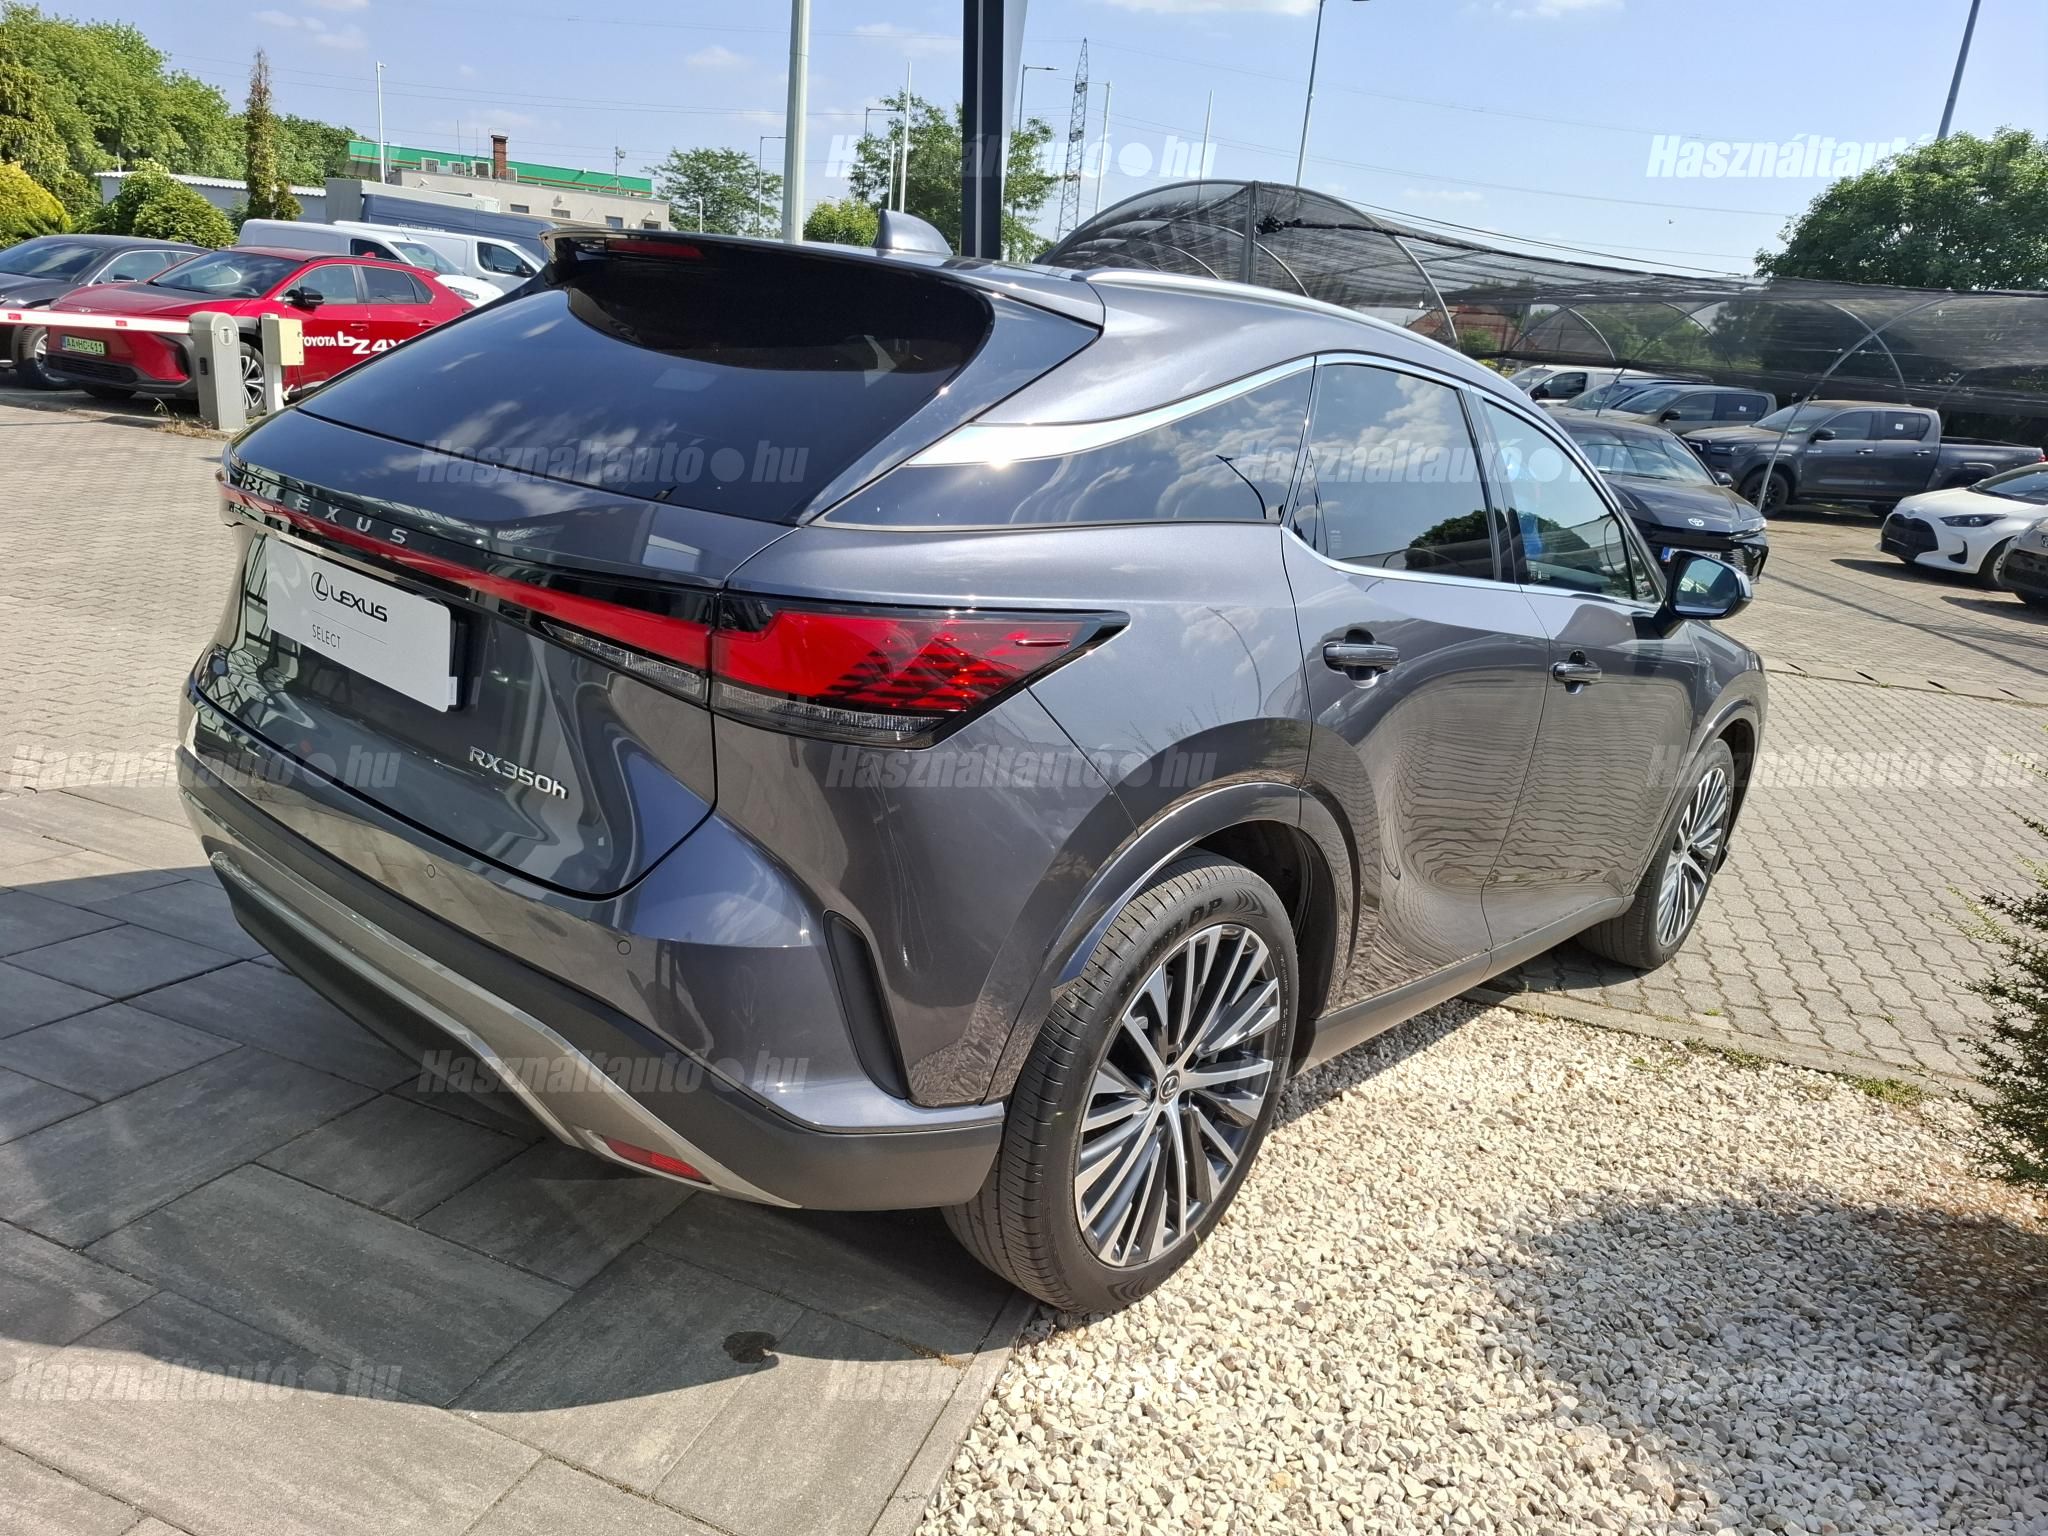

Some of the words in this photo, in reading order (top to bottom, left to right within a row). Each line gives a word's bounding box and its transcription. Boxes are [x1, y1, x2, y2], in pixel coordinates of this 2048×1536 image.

[302, 336, 337, 347] OYOTA
[330, 584, 388, 623] LEXUS
[312, 623, 341, 649] SELECT
[469, 745, 568, 800] RX350h
